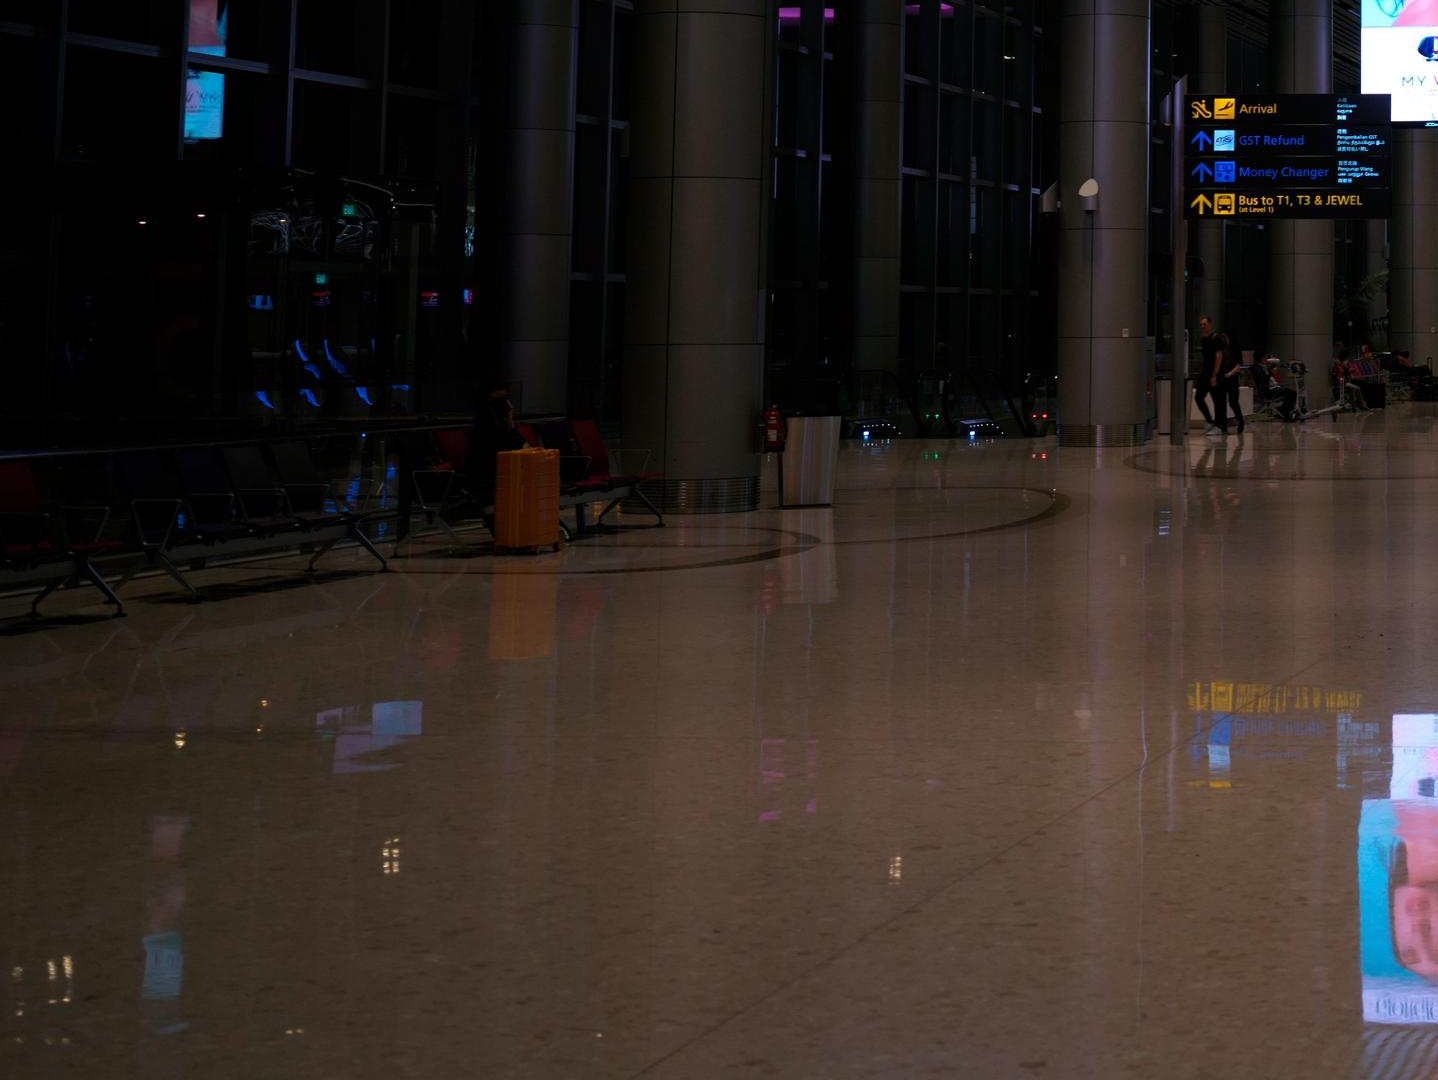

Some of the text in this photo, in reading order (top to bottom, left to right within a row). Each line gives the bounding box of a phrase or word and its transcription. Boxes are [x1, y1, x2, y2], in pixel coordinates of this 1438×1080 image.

[1402, 75, 1426, 87] MY
[1239, 103, 1277, 114] Arrival
[1239, 134, 1305, 146] GST Refund
[1239, 166, 1329, 180] Money Changer
[1238, 195, 1364, 207] Bus to T1, T3 & JEWEL
[1238, 206, 1248, 214] (at
[1267, 206, 1275, 214] 1)
